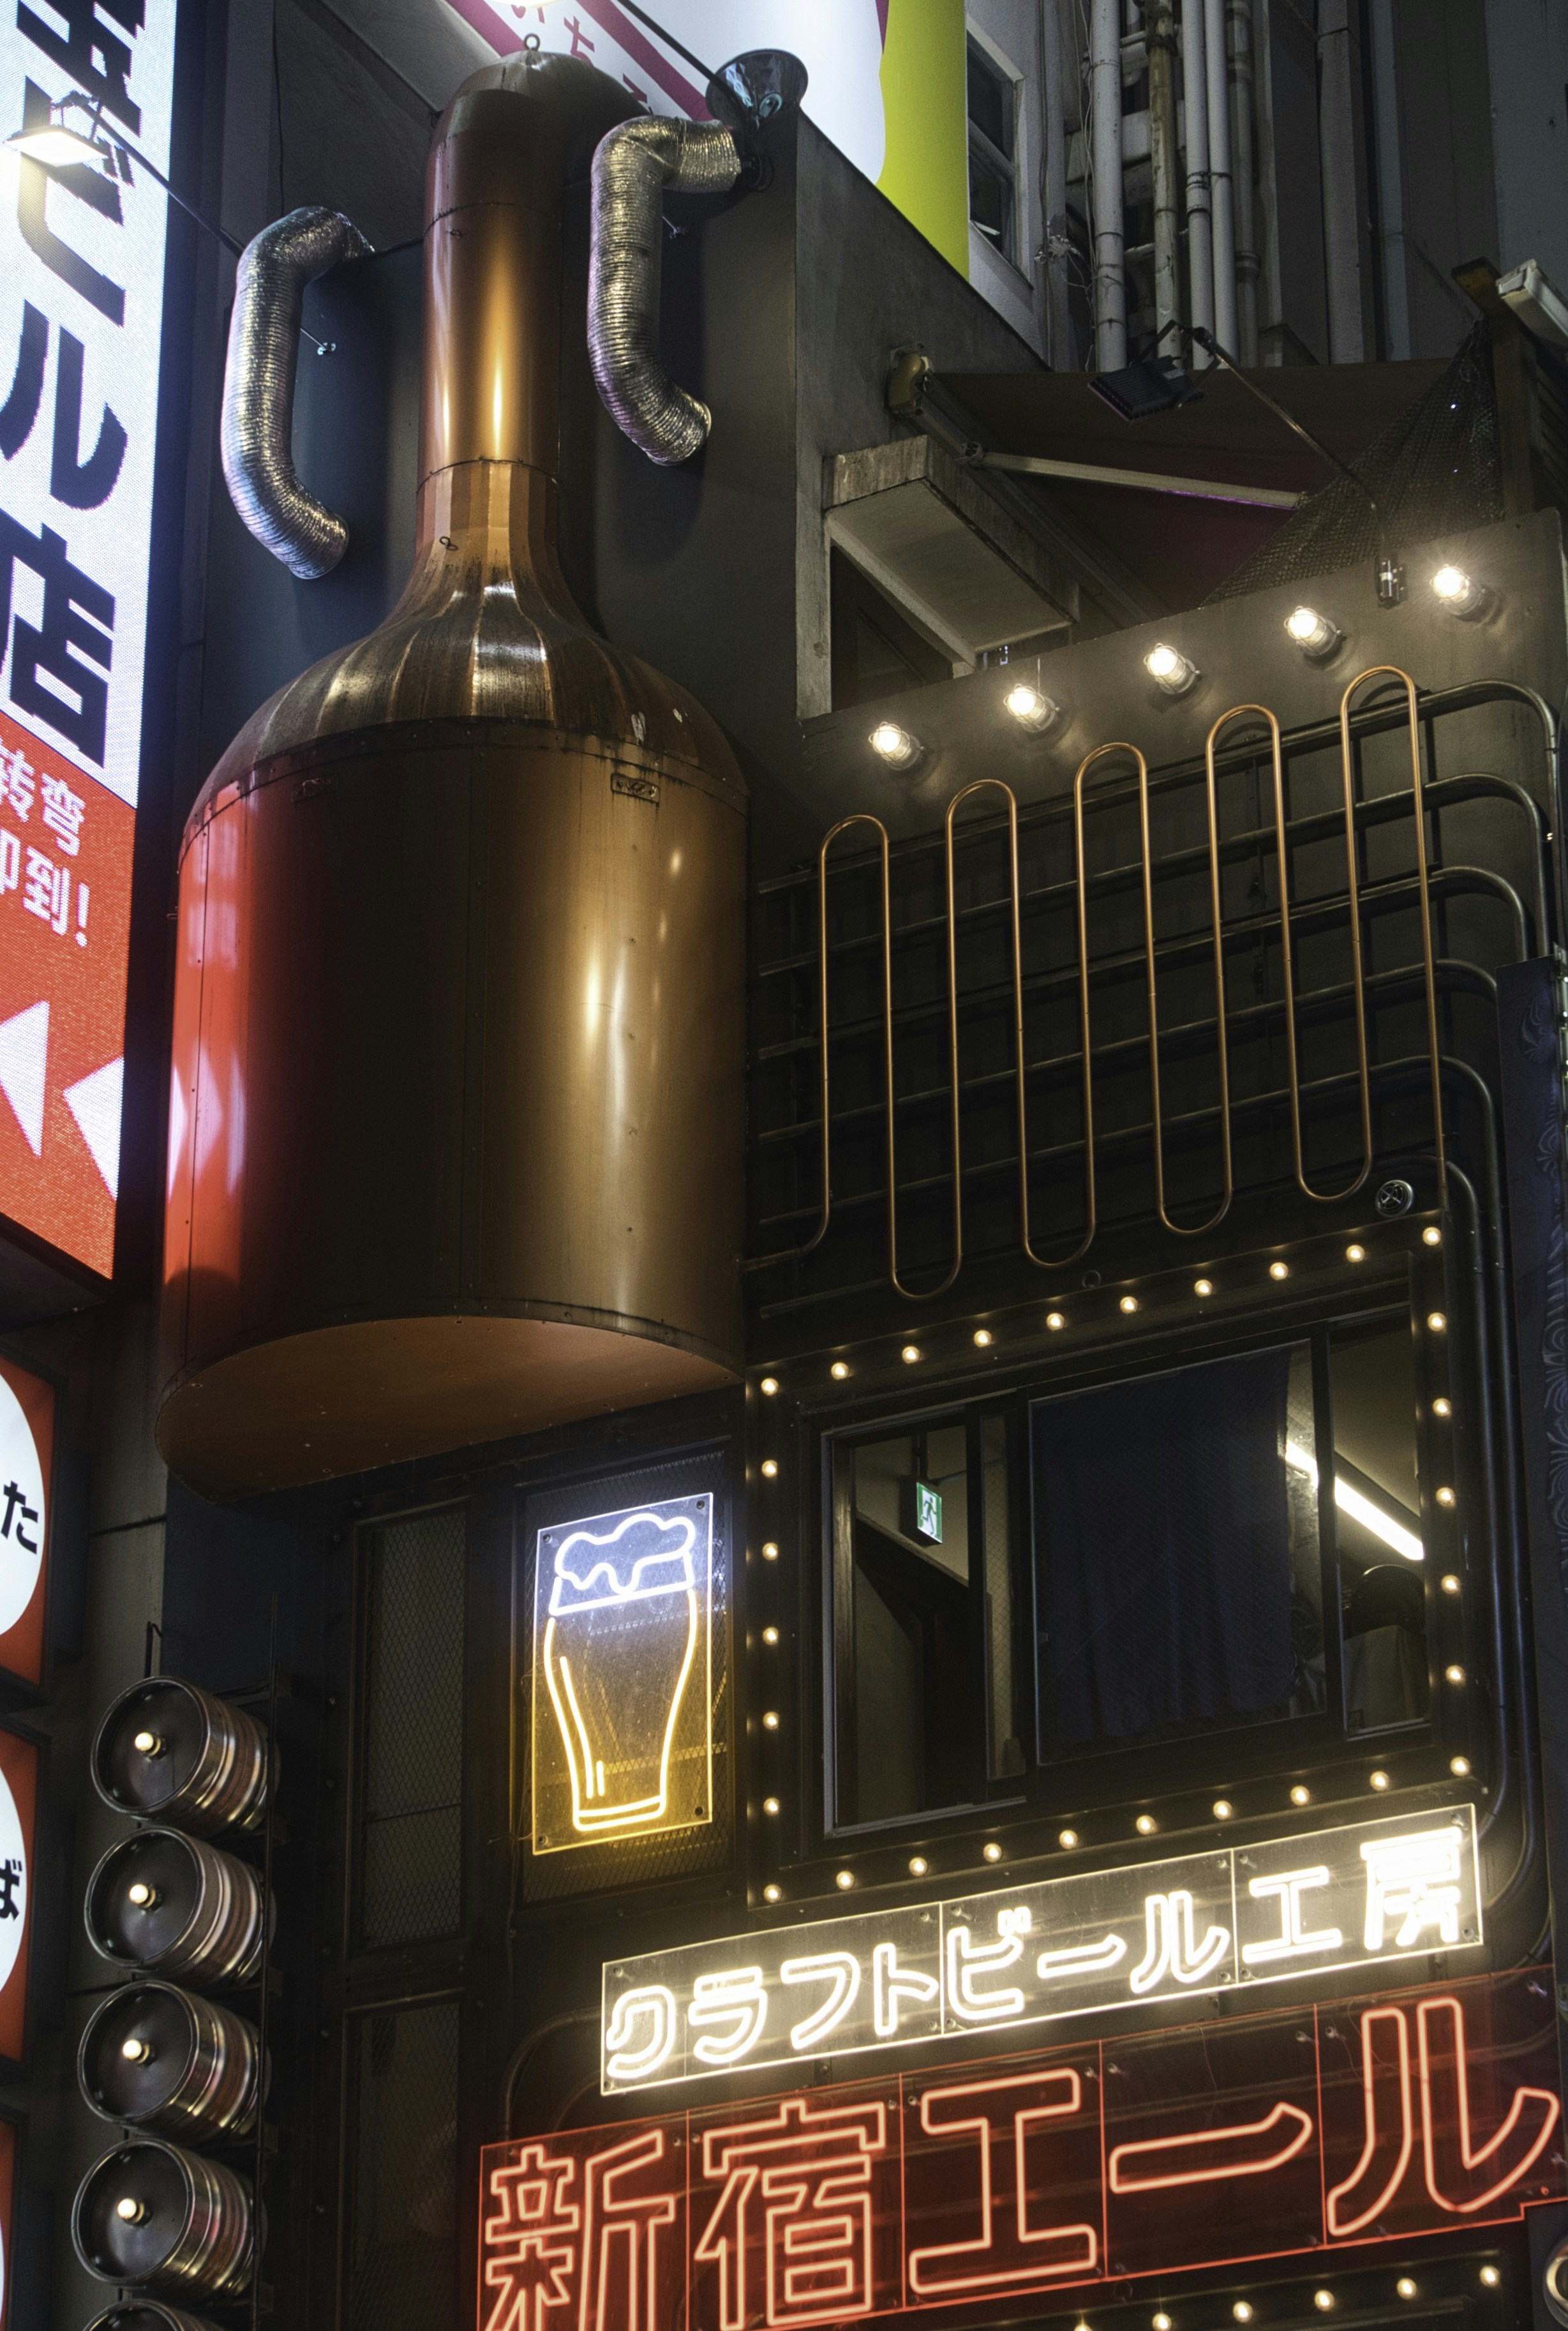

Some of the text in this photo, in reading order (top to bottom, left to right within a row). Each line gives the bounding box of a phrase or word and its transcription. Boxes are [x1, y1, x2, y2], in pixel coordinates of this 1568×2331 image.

[606, 1825, 1463, 2079] クラフトビール工房
[484, 1996, 1560, 2331] 新宿エール
